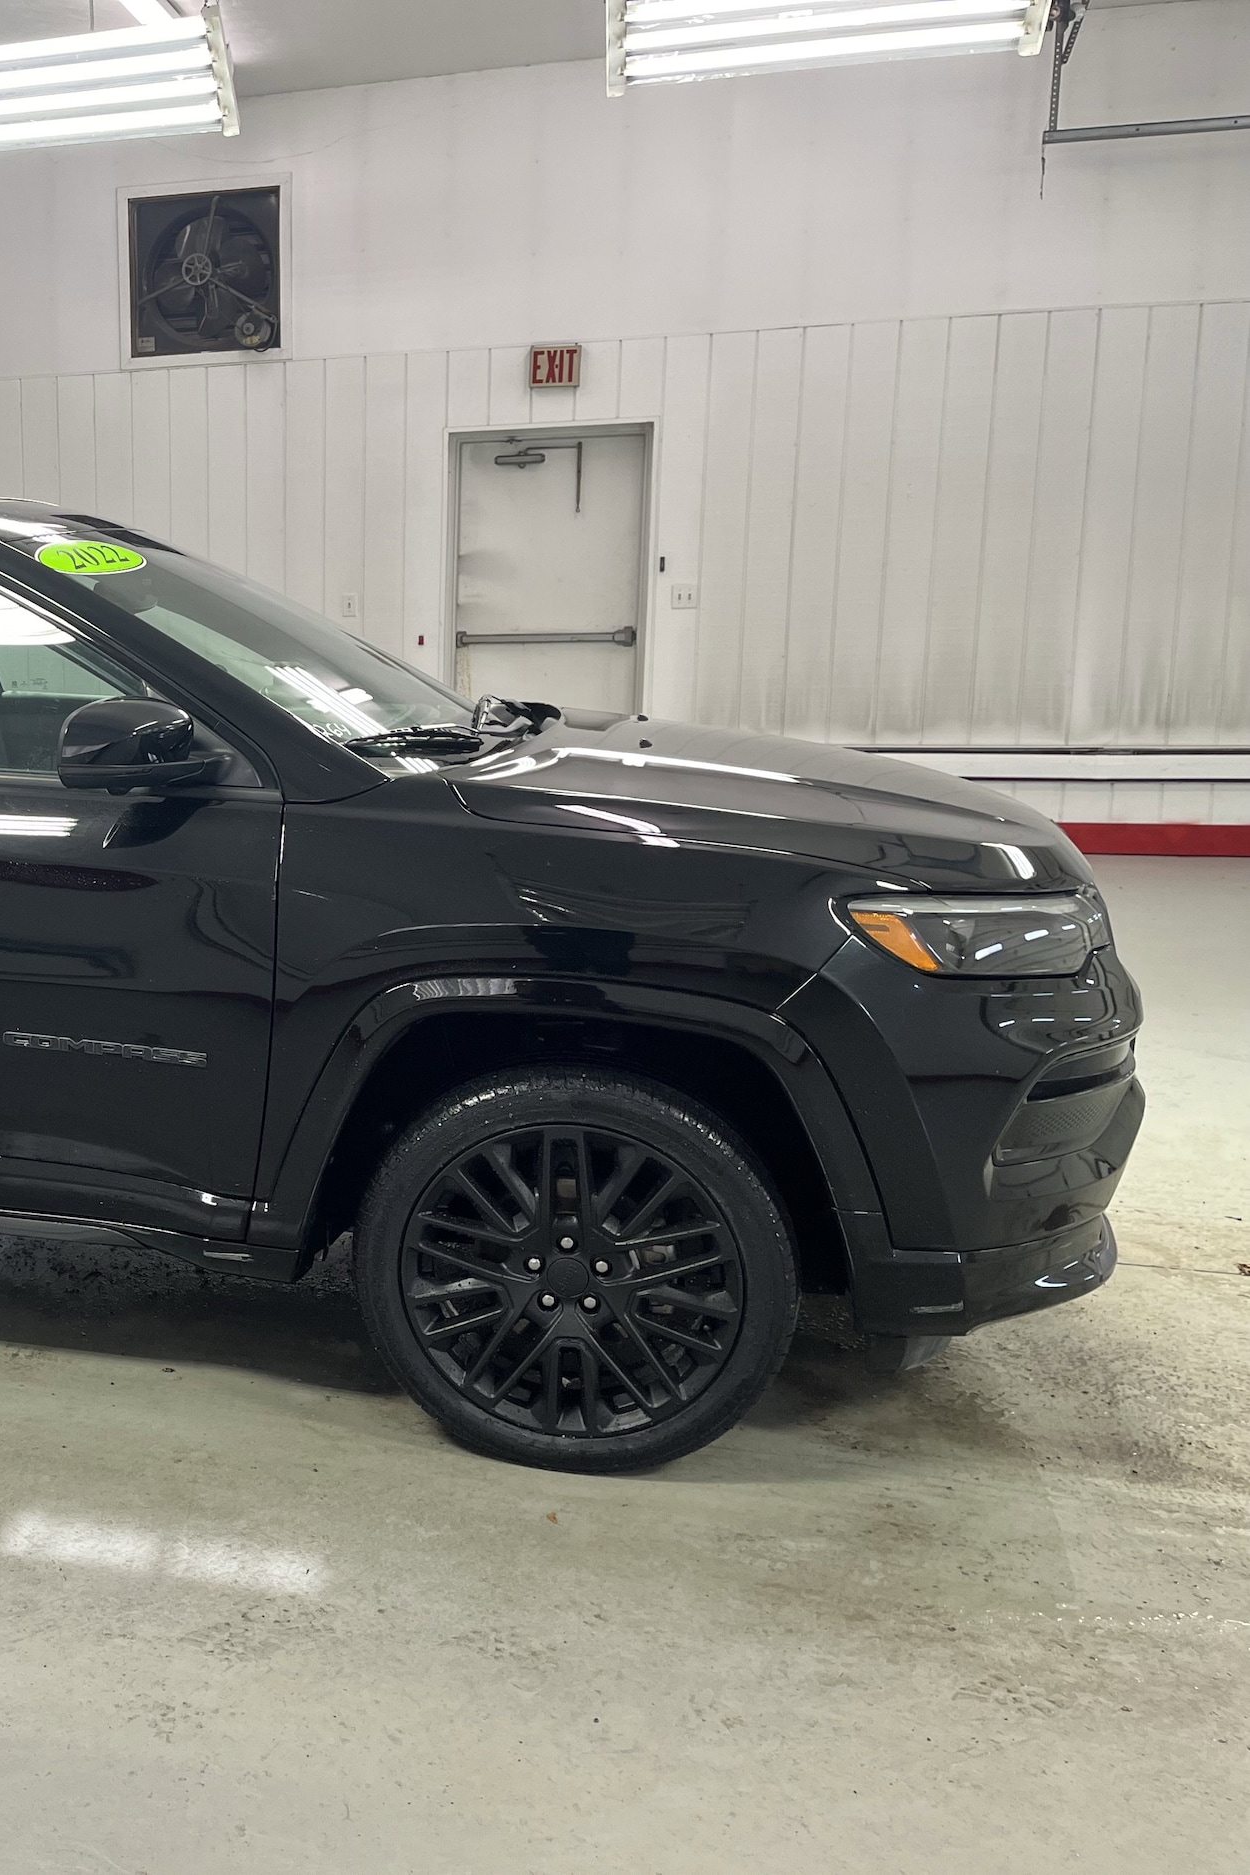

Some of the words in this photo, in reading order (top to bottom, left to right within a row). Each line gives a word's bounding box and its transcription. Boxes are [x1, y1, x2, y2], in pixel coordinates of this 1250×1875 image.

[532, 349, 577, 384] EXIT
[56, 545, 130, 570] 2022
[2, 1030, 208, 1068] COMPASS
